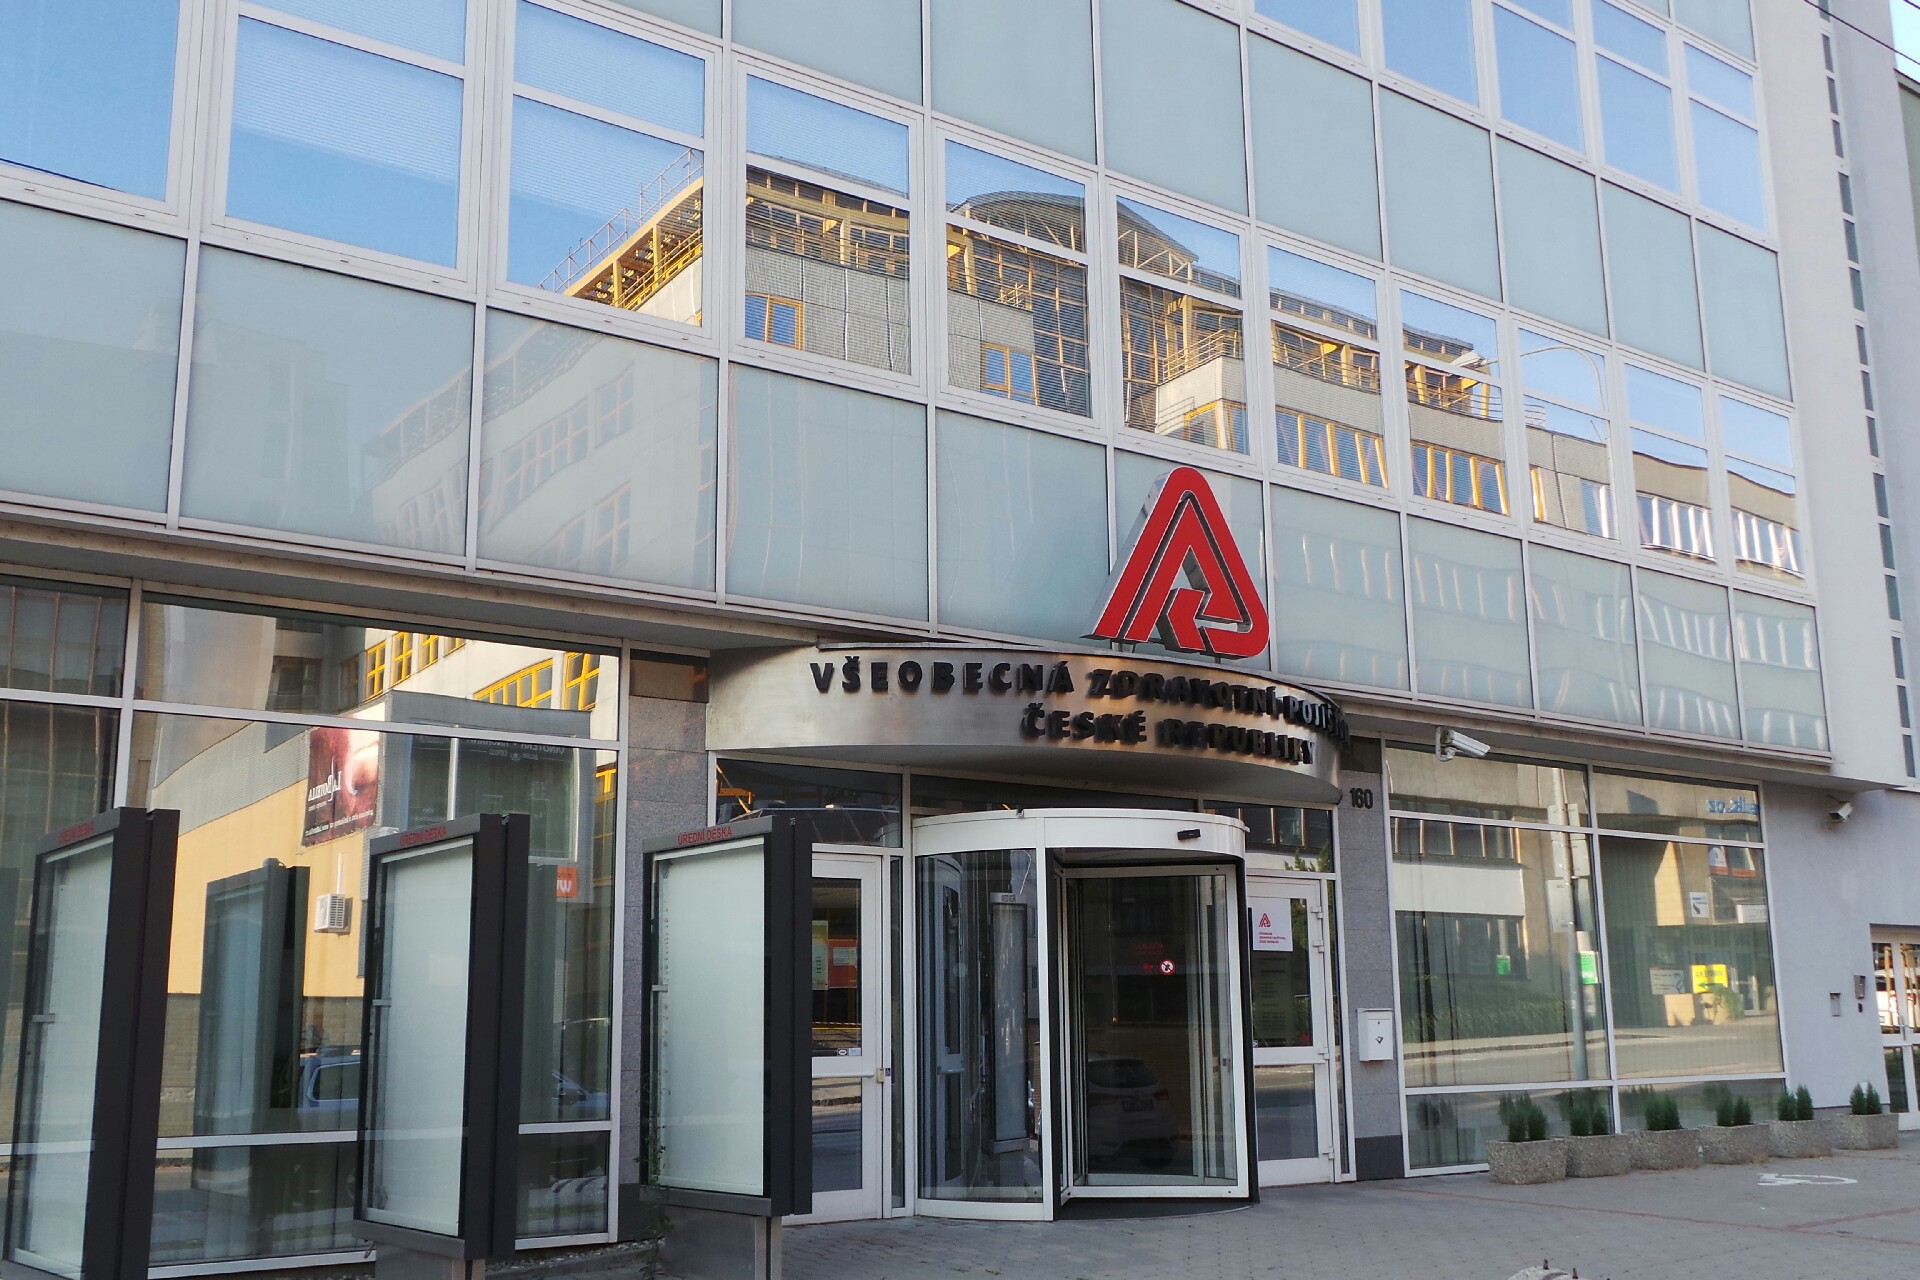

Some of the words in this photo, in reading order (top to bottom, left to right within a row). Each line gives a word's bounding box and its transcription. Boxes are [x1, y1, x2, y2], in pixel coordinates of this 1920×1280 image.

[809, 655, 1075, 694] VŠEOBECNÁ
[1088, 668, 1278, 718] ZDRAVOTNÍ
[1021, 702, 1148, 743] ČESKÉ
[1157, 718, 1317, 765] REPUBLIKY
[1350, 787, 1374, 810] 160
[678, 829, 704, 844] ÚŘEDNÍ
[707, 826, 732, 840] DESKA
